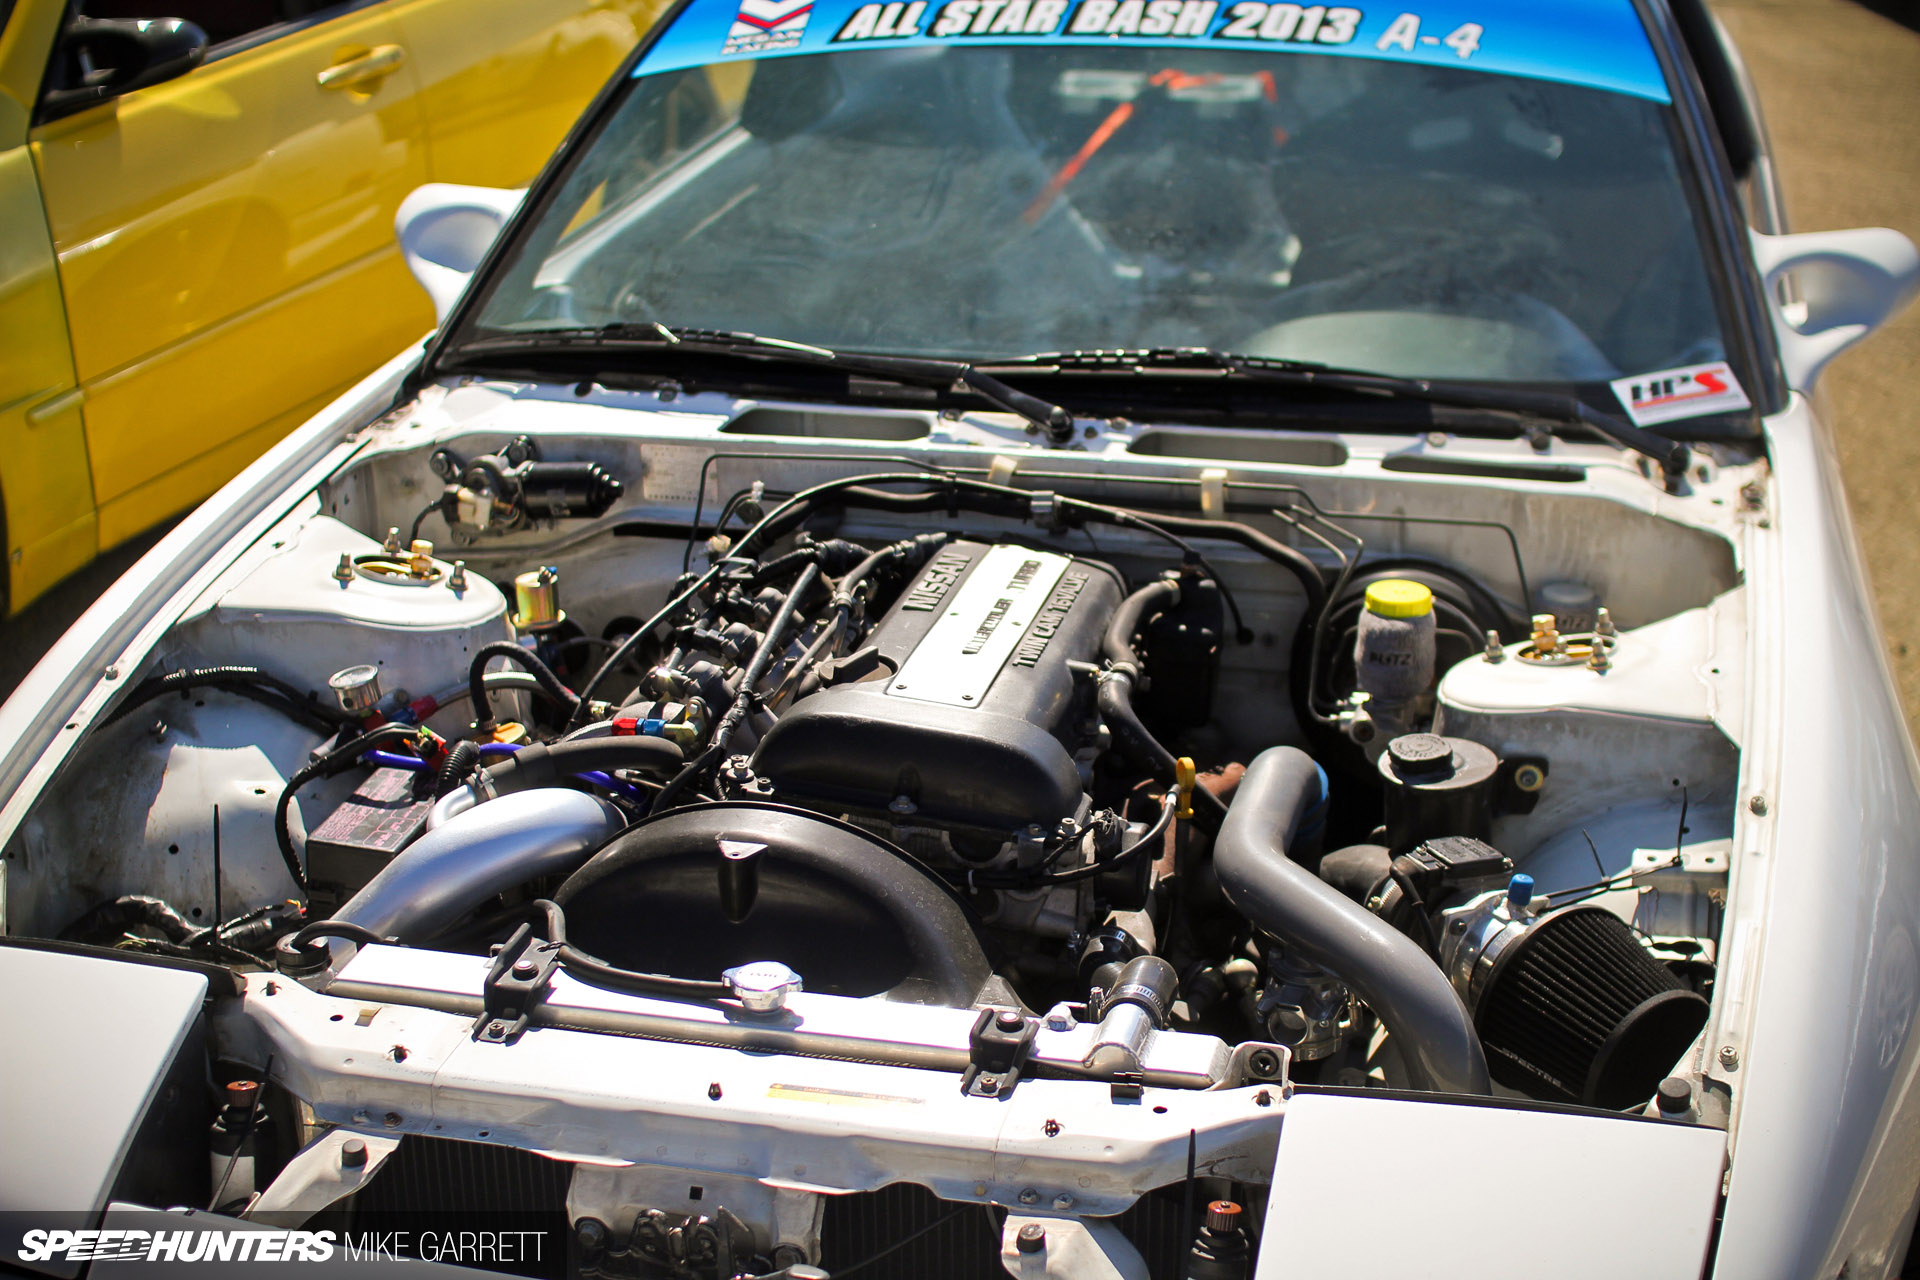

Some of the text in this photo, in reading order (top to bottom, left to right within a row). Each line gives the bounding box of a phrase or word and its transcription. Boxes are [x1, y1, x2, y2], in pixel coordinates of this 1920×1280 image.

[833, 0, 1484, 60] ALL STAR BASH 2013 A-4
[1630, 369, 1728, 404] HPS
[902, 552, 972, 612] NISSAN
[1012, 638, 1049, 669] TWIN
[1032, 614, 1064, 640] CAM
[1501, 1046, 1562, 1088] SPECTRE
